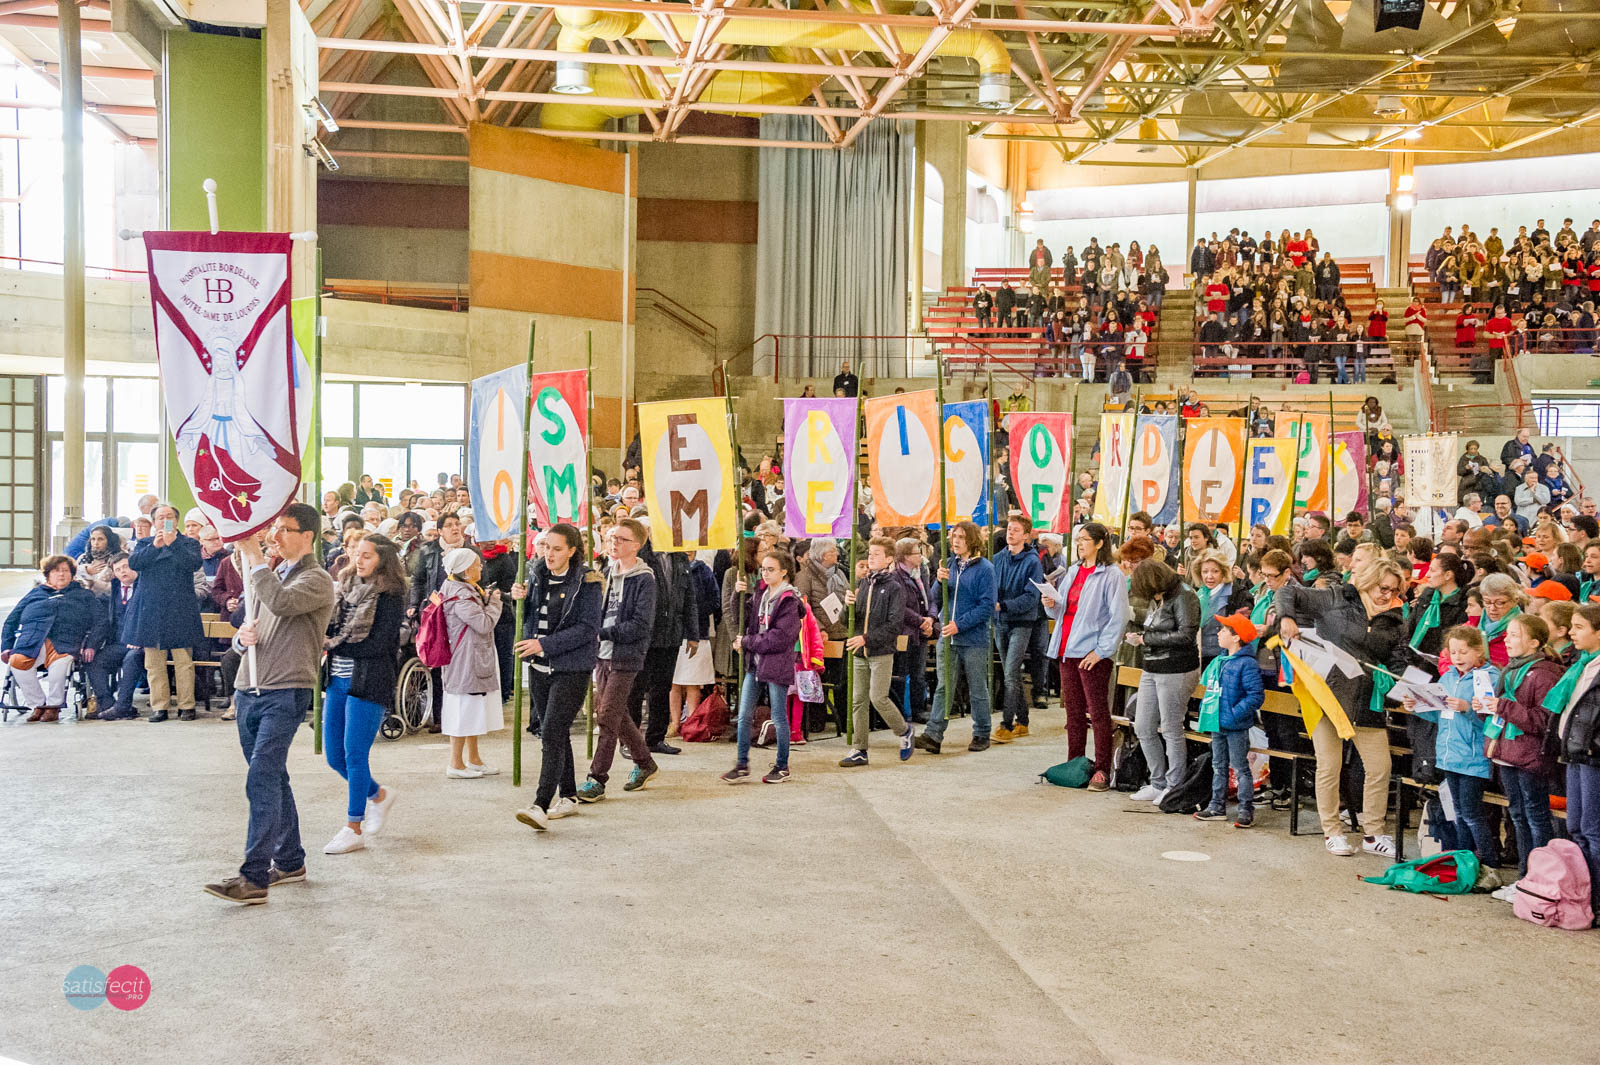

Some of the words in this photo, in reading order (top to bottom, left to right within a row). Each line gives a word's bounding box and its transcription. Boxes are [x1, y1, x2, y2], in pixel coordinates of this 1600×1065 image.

[203, 278, 234, 304] HB
[219, 262, 260, 290] BORDELAISE
[182, 295, 220, 321] NOTRE-DAME
[223, 312, 234, 322] DE
[236, 296, 260, 320] LOURDES
[537, 386, 566, 446] S
[807, 410, 834, 465] R
[896, 405, 910, 456] I
[943, 415, 966, 462] C
[667, 413, 701, 472] E
[1029, 423, 1053, 469] O
[1143, 424, 1161, 466] D
[1252, 446, 1275, 485] E
[493, 469, 514, 533] O
[543, 463, 579, 524] M
[805, 481, 834, 534] E
[946, 478, 973, 526] L
[1032, 484, 1053, 530] E
[1142, 480, 1161, 513] P
[1199, 480, 1222, 520] E
[1251, 497, 1272, 526] R
[669, 489, 709, 547] M
